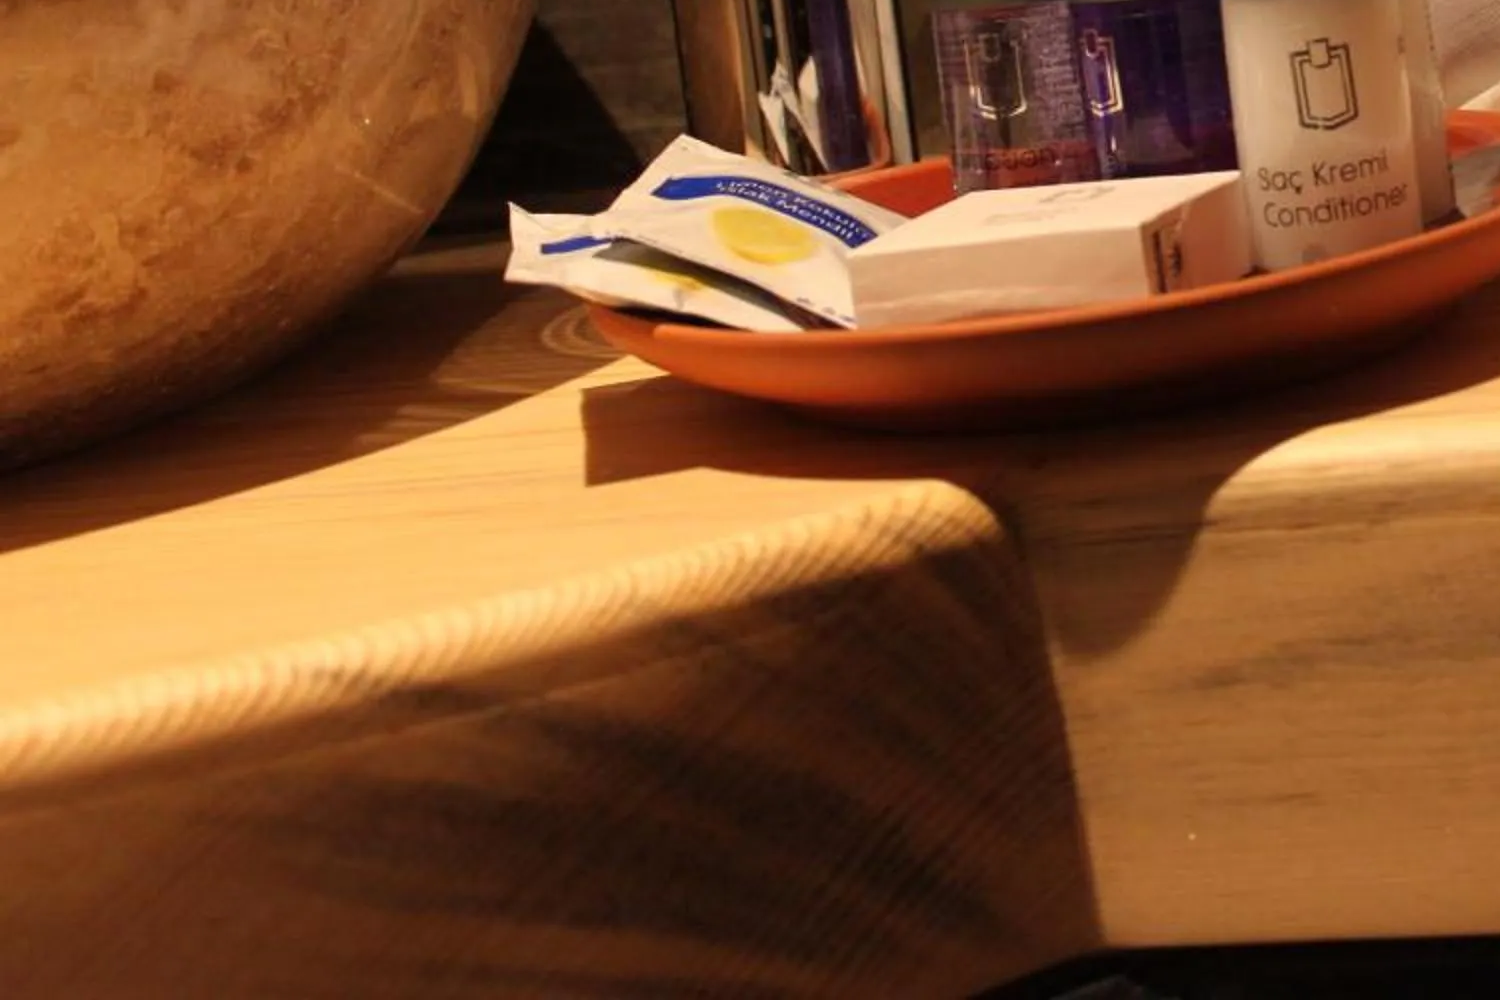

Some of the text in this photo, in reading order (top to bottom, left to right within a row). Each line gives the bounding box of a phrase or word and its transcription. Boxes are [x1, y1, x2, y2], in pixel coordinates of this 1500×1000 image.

[1257, 149, 1389, 194] Saç Kremi
[1263, 183, 1408, 228] Conditioner
